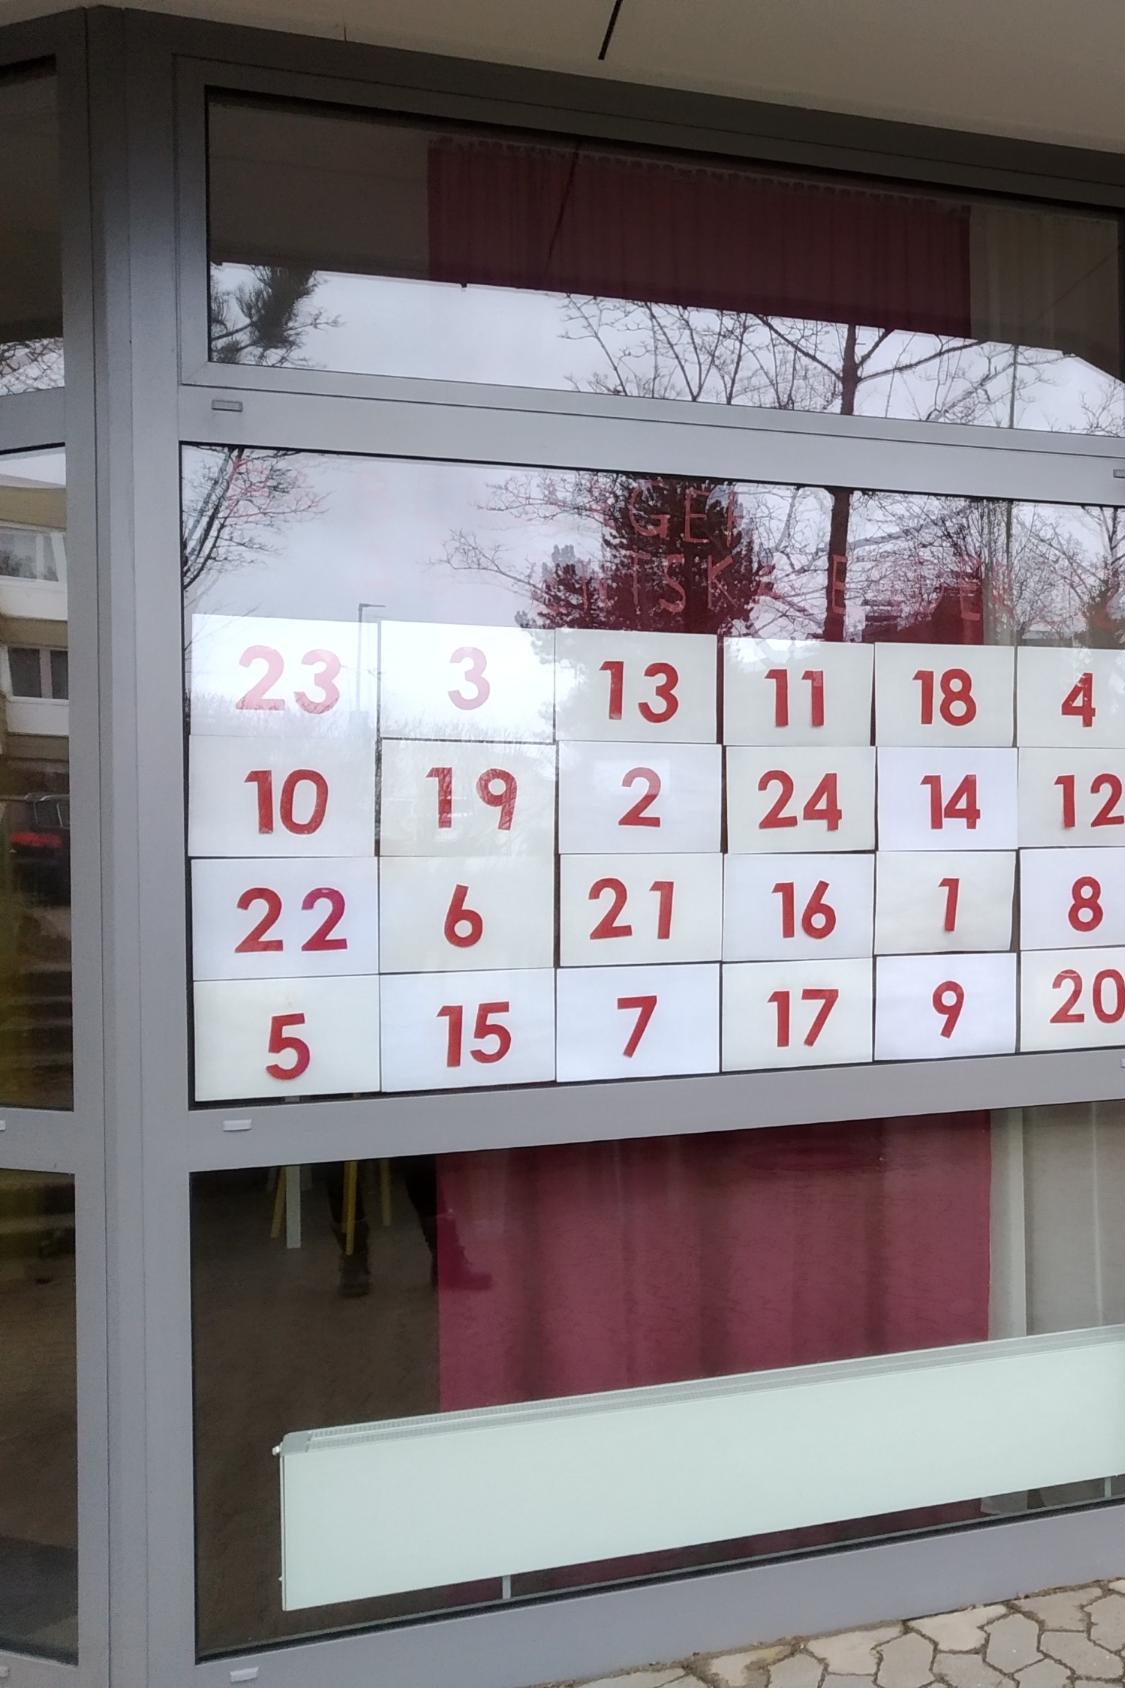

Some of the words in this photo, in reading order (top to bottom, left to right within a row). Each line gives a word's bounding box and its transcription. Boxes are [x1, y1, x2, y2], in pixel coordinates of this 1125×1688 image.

[236, 645, 341, 714] 23
[448, 646, 490, 710] 3
[601, 661, 679, 724] 13
[767, 668, 825, 727] 11
[914, 668, 977, 726] 18
[1061, 672, 1097, 728] 4
[246, 769, 329, 835] 10
[428, 767, 517, 830] 19
[618, 769, 661, 828] 2
[758, 770, 843, 831] 24
[922, 774, 981, 830] 14
[1055, 772, 1125, 829] 12
[235, 887, 348, 953] 22
[444, 885, 484, 948] 6
[589, 877, 675, 940] 21
[773, 880, 837, 939] 16
[940, 877, 960, 932] 1
[1067, 875, 1104, 933] 8
[438, 1001, 512, 1067] 15
[617, 995, 657, 1057] 7
[769, 988, 839, 1048] 17
[932, 980, 965, 1037] 9
[266, 1013, 311, 1080] 5
